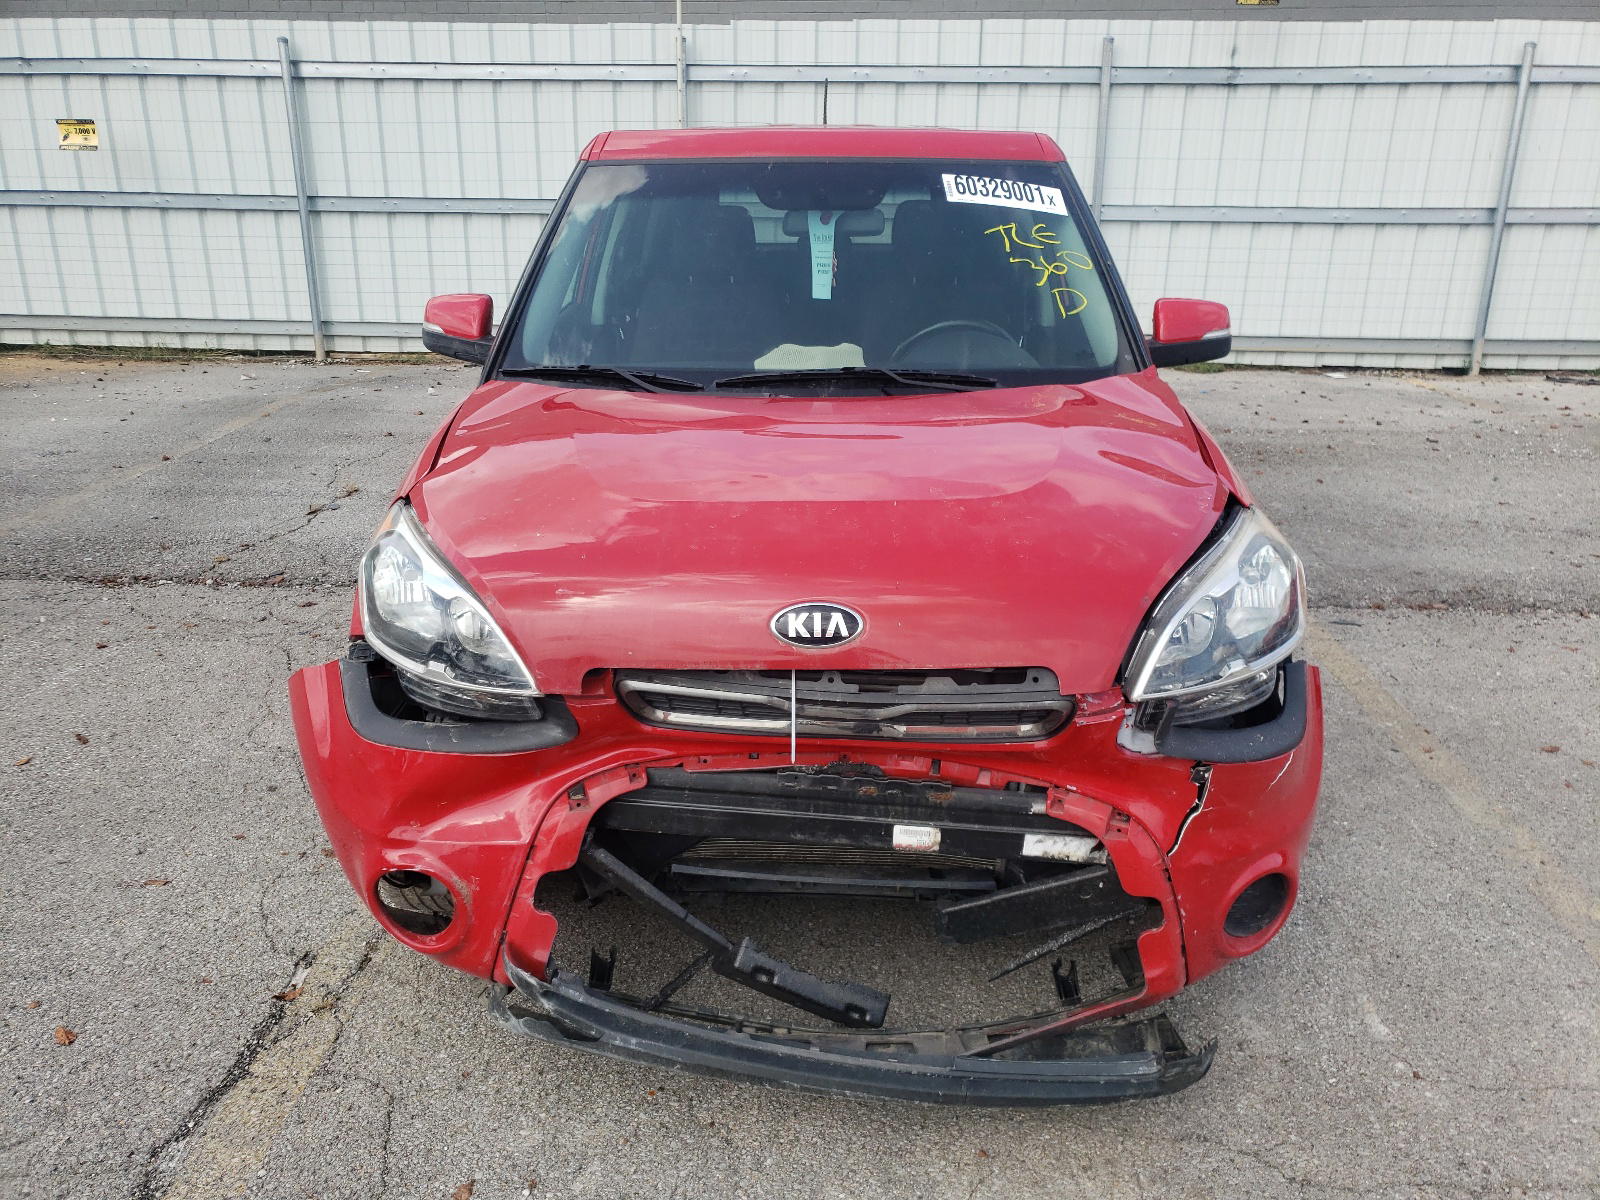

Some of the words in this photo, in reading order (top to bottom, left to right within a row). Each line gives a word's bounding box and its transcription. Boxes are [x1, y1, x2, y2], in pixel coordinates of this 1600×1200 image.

[1010, 251, 1093, 286] 360
[1051, 288, 1088, 319] D
[787, 612, 849, 638] KIA
